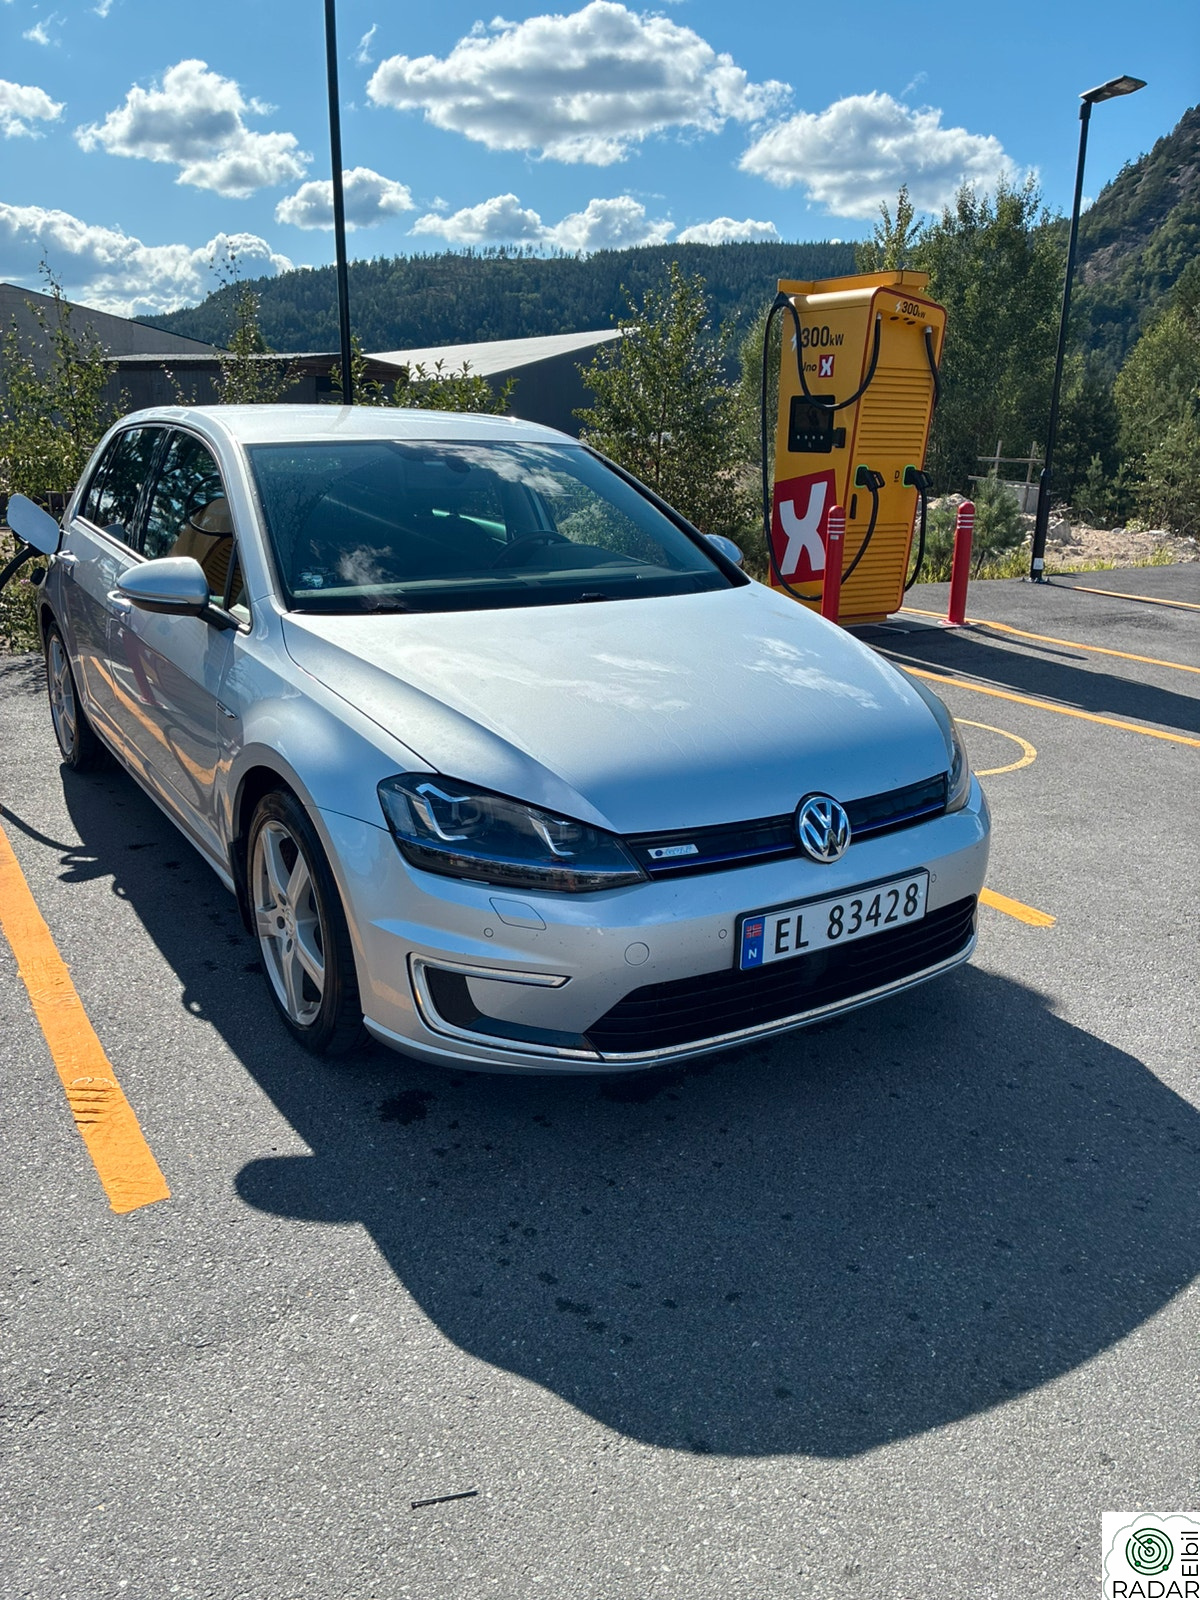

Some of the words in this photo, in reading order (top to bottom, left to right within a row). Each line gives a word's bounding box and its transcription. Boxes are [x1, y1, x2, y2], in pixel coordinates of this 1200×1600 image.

[820, 356, 834, 376] X
[779, 481, 828, 575] X
[775, 915, 809, 954] EL
[827, 883, 919, 940] 83428
[748, 949, 757, 960] N
